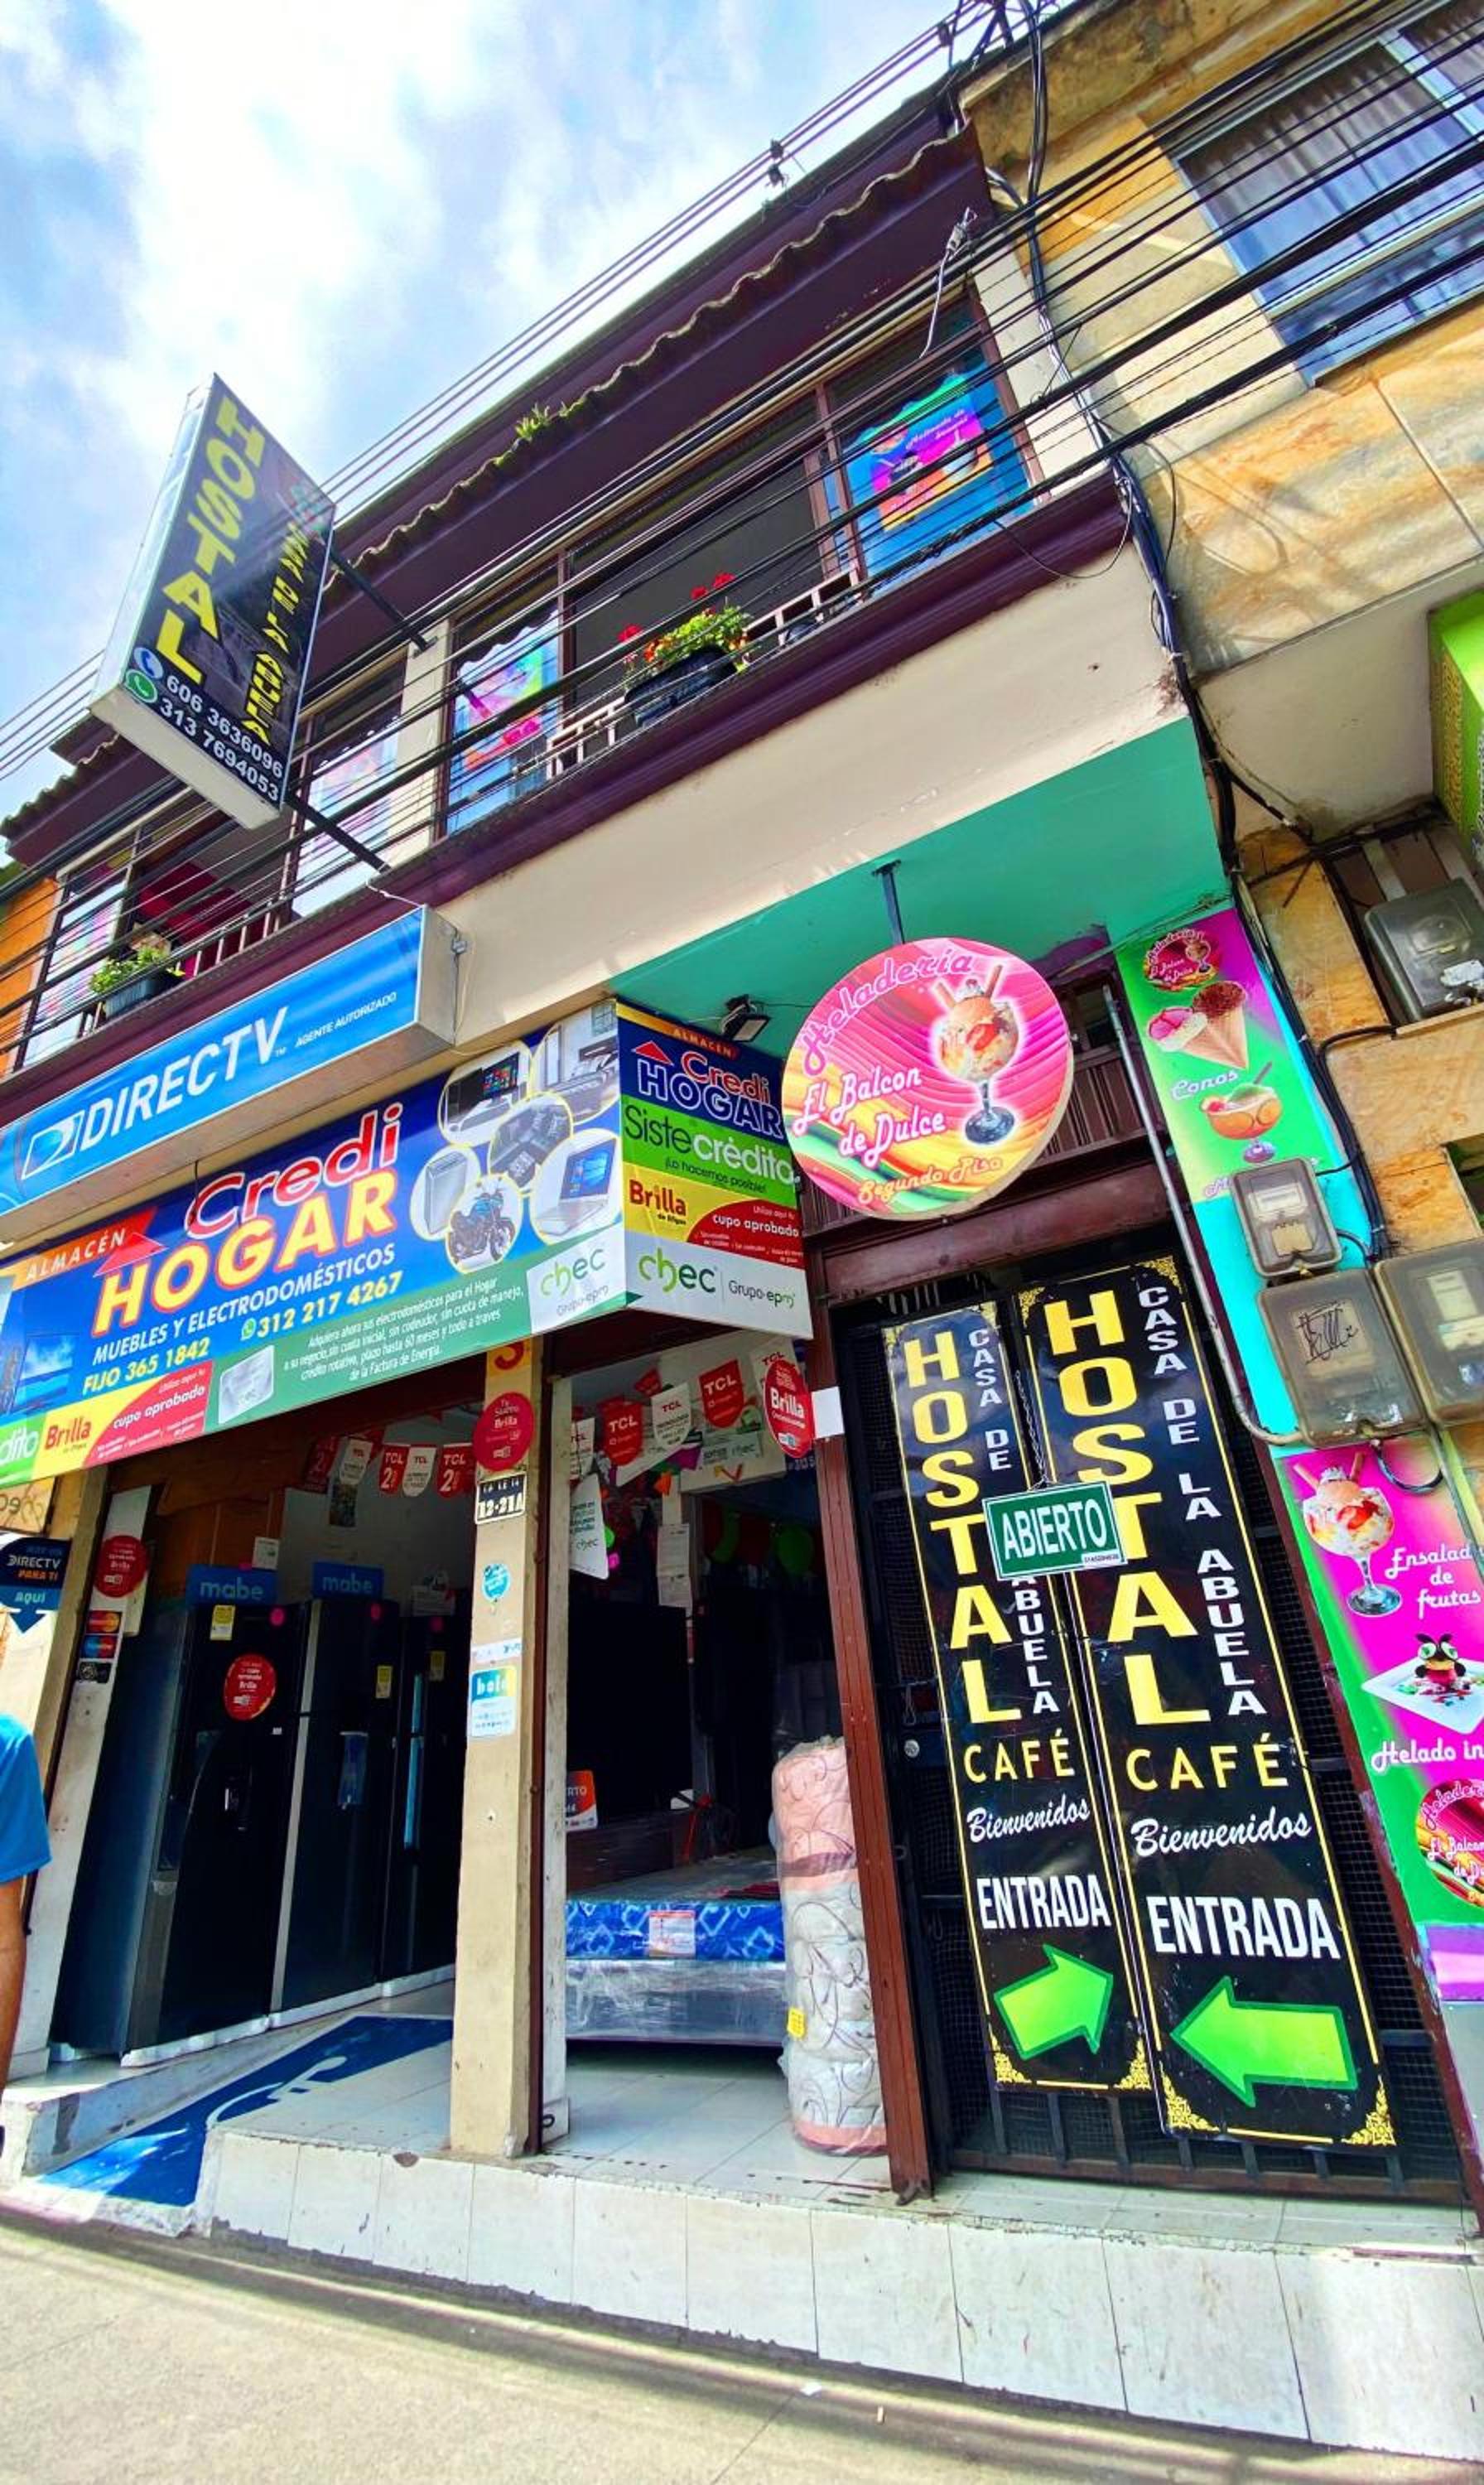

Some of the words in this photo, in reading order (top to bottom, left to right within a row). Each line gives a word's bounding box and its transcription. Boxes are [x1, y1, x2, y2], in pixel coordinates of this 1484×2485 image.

[156, 395, 266, 686] HOSTAL
[272, 577, 299, 615] DE
[262, 610, 289, 653] LA
[160, 698, 196, 739] 313
[202, 730, 280, 803] 7694053
[166, 674, 202, 714] 606
[207, 707, 284, 779] 3636096
[295, 1021, 335, 1048] AGENTE
[335, 992, 397, 1029] AUTORIZADO
[75, 1006, 289, 1151] DIRECTV
[638, 1059, 784, 1139] HOGAR
[681, 1050, 770, 1104] Credi
[1172, 1070, 1238, 1100] Conos
[793, 1080, 826, 1136] El
[831, 1067, 922, 1122] Balcon
[840, 1128, 866, 1156] de
[864, 1104, 946, 1168] Dulce
[185, 1102, 402, 1240] Credi
[682, 1163, 732, 1185] hacemos
[858, 1165, 942, 1204] Segundo
[949, 1156, 1001, 1182] Piso
[629, 1179, 687, 1217] Brilla
[712, 1214, 741, 1228] cupo
[744, 1219, 799, 1238] aprobado
[25, 1228, 127, 1282] ALMACÉN
[92, 1169, 398, 1338] HOGAR
[92, 1322, 168, 1366] MUEBLES
[172, 1317, 186, 1339] Y
[187, 1244, 397, 1334] ELECTRODOMÉSTICOS
[445, 1289, 463, 1305] para
[465, 1284, 473, 1296] el
[475, 1277, 498, 1295] Hogar
[83, 1365, 120, 1396] FIJO
[124, 1356, 159, 1383] 365
[165, 1339, 212, 1372] 1842
[256, 1310, 296, 1339] 312
[301, 1291, 340, 1325] 217
[346, 1271, 404, 1306] 4267
[383, 1340, 402, 1355] hasta
[441, 1326, 447, 1339] y
[388, 1326, 399, 1338] sin
[441, 1308, 453, 1320] sin
[479, 1295, 488, 1308] de
[1138, 1285, 1188, 1376] CASA
[349, 1368, 359, 1381] de
[399, 1353, 410, 1366] de
[705, 1373, 737, 1394] TCL
[113, 1411, 142, 1429] cupo
[144, 1384, 205, 1419] aprobado
[609, 1414, 638, 1433] TCL
[662, 1400, 681, 1413] TCL
[770, 1387, 805, 1417] Brilla
[1162, 1397, 1201, 1445] DE
[45, 1416, 91, 1450] Brilla
[385, 1452, 404, 1465] TCL
[443, 1454, 466, 1465] TCL
[1043, 1290, 1212, 1726] HOSTAL
[1178, 1472, 1221, 1520] LA
[903, 1331, 1022, 1725] HOSTAL
[968, 1327, 996, 1407] CASA
[984, 1428, 1012, 1470] DE
[1007, 1575, 1061, 1715] BUELA
[1002, 1498, 1107, 1561] ABIERTO
[7, 1555, 60, 1570] DIRECTV
[322, 1574, 373, 1595] mabe
[1430, 1565, 1455, 1585] de
[200, 1578, 264, 1600] mabe
[1417, 1589, 1481, 1619] frutas
[1197, 1547, 1268, 1717] ABUELA
[963, 1729, 1076, 1783] CAFÉ
[1125, 1732, 1289, 1791] CAFÉ
[1371, 1737, 1457, 1773] Helado
[966, 1794, 1091, 1842] Bienvenidos
[1130, 1806, 1313, 1857] Bienvenidos
[976, 1874, 1112, 1930] ENTRADA
[1145, 1894, 1341, 1959] ENTRADA
